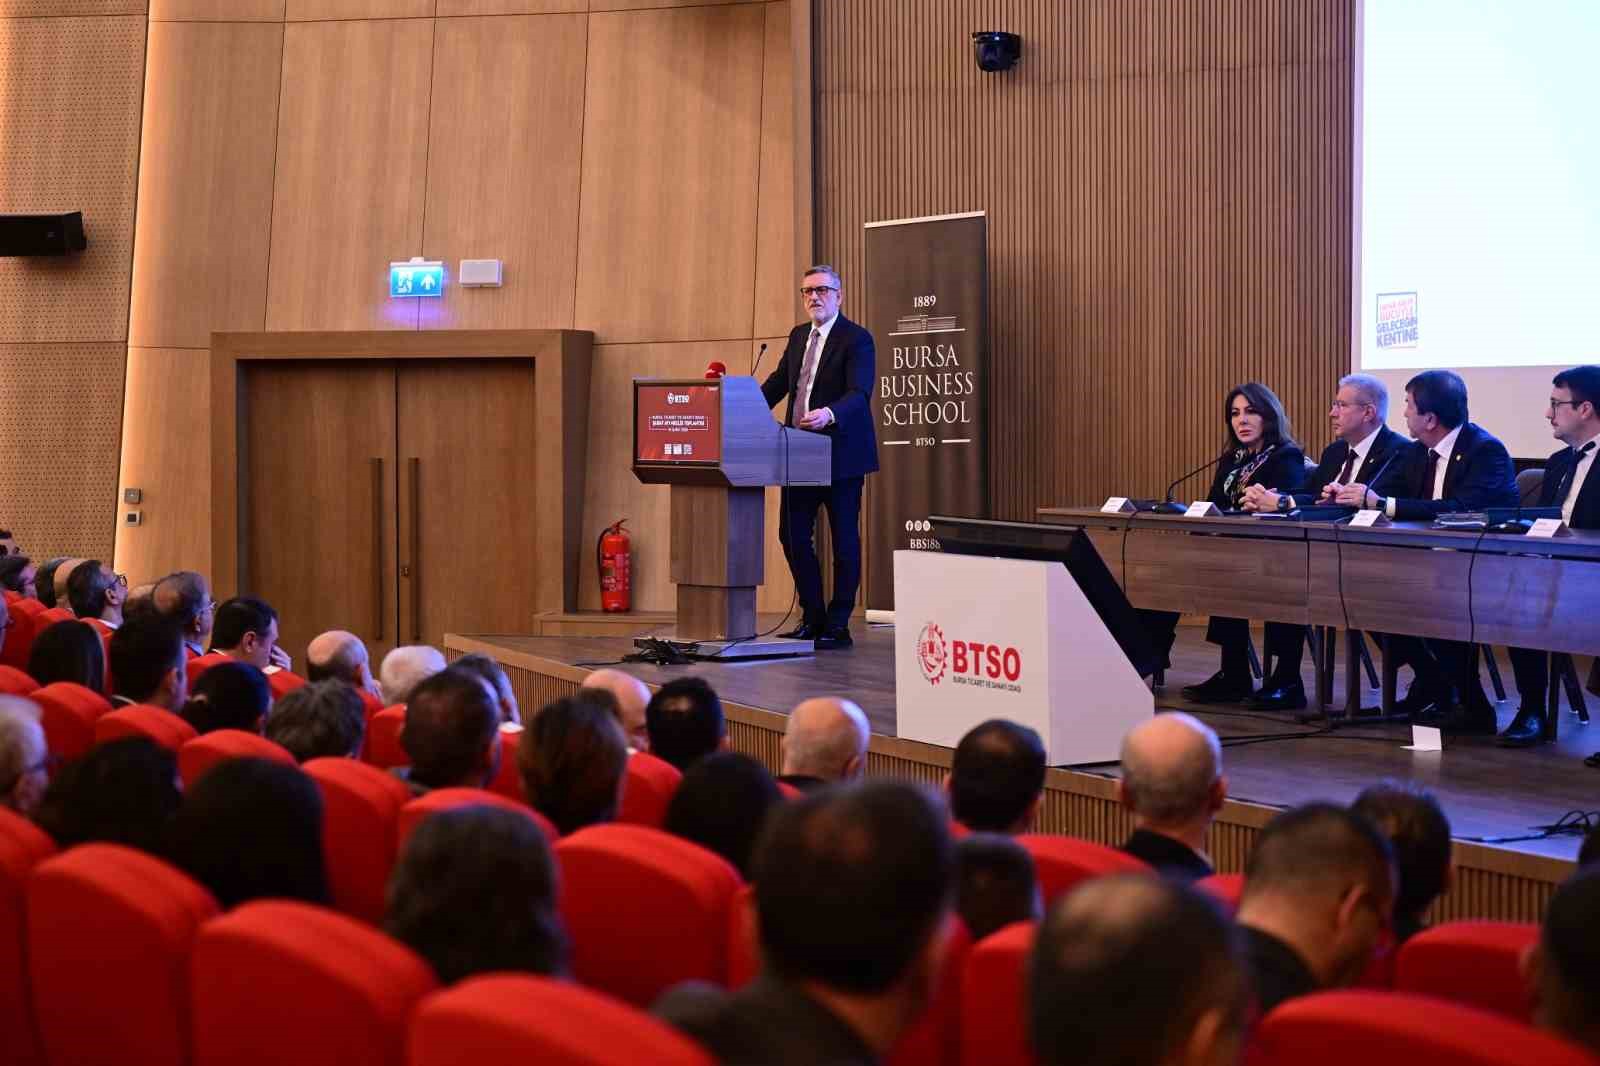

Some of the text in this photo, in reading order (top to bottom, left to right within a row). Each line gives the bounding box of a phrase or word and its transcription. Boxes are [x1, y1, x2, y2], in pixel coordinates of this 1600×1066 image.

[913, 295, 937, 308] 1889
[893, 344, 960, 369] BURSA
[880, 371, 974, 398] BUSINESS
[883, 401, 971, 426] SCHOOL
[916, 437, 935, 447] BTSO
[952, 640, 1021, 682] BTSO
